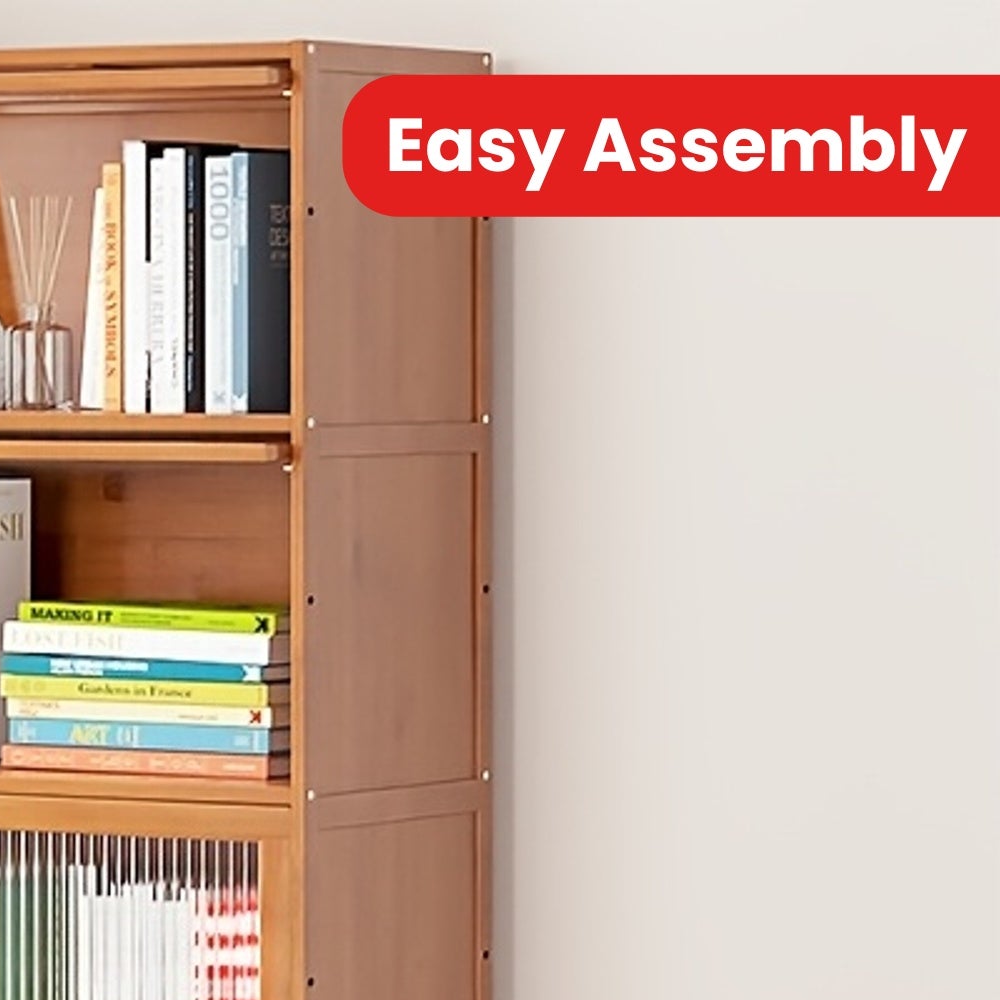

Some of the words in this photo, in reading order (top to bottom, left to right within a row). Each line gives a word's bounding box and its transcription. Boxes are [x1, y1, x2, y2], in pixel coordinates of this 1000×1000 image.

[210, 166, 229, 241] 1000
[30, 607, 94, 623] MAKING
[97, 610, 114, 624] IT
[77, 682, 130, 696] Gardens
[133, 685, 147, 697] in
